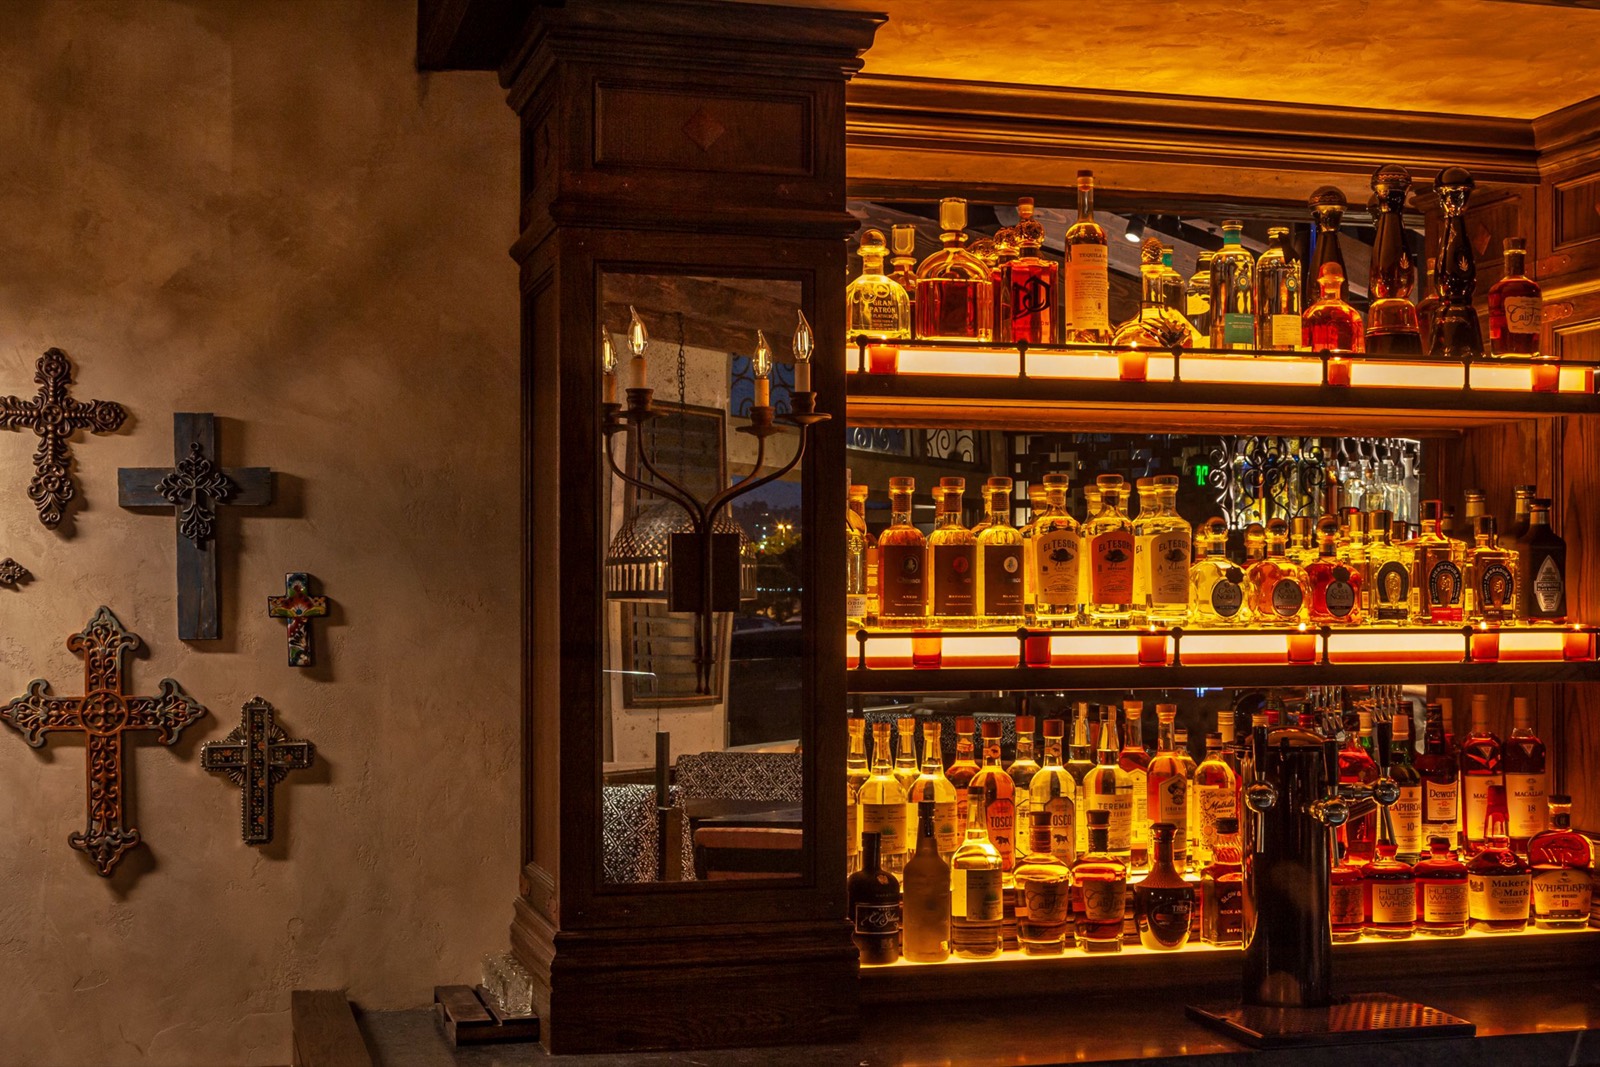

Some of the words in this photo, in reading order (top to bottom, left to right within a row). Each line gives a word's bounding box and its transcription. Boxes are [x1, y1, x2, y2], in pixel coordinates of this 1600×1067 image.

[1043, 543, 1051, 552] EL
[1098, 544, 1106, 553] EL
[1158, 544, 1167, 552] EL
[1527, 804, 1536, 812] 18
[1053, 814, 1072, 826] OSCO
[1407, 822, 1415, 831] 10
[1503, 888, 1529, 897] Mark
